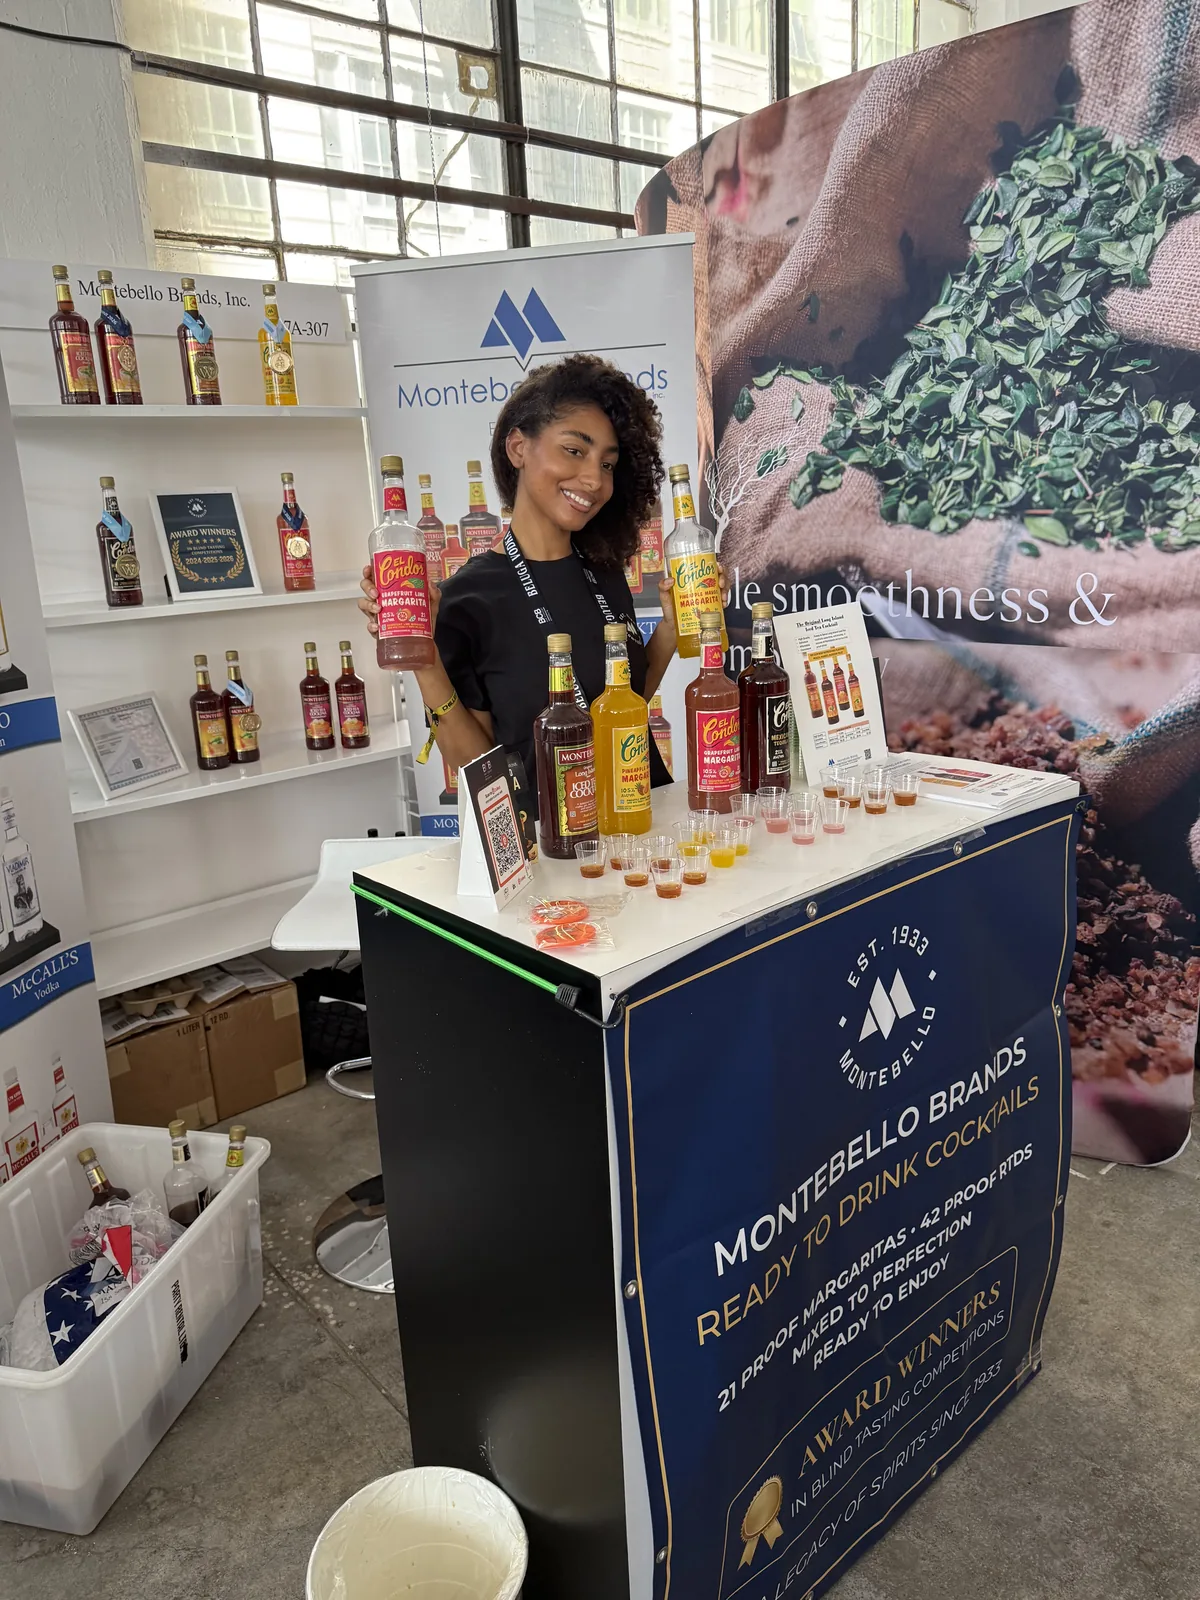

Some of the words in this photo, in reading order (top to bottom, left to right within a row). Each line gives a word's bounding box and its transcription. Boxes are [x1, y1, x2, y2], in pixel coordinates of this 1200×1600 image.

[167, 287, 222, 307] Brnds,
[225, 291, 250, 307] Inc.
[170, 529, 198, 540] AWARD
[200, 528, 237, 536] WINNERS
[504, 531, 521, 561] VODKA
[393, 556, 405, 567] EL
[690, 561, 698, 570] EL
[515, 561, 538, 597] BELUGA
[381, 590, 413, 598] GRAPEFRUIT
[381, 598, 427, 608] MARGARITA
[679, 592, 703, 600] PINEAPPLE
[680, 595, 719, 608] MARGARITA
[772, 568, 1049, 622] smoothness
[1068, 572, 1119, 626] &
[534, 608, 546, 624] BCB
[594, 594, 617, 624] BELUG
[718, 718, 729, 728] EL
[636, 735, 645, 744] EL
[621, 766, 646, 774] PINEAPPLE
[572, 780, 590, 791] ICED
[847, 938, 885, 988] EST.
[891, 925, 929, 956] 1933
[34, 980, 60, 1001] Vodka
[176, 1028, 181, 1037] 1
[182, 1021, 201, 1036] LITER
[209, 1016, 218, 1026] 12
[839, 1006, 936, 1090] MONTEBELLO
[713, 1105, 920, 1277] MONTEBELLO
[928, 1036, 1027, 1124] BRANDS
[696, 1244, 798, 1346] READY
[802, 1214, 831, 1259] TO
[838, 1151, 919, 1227] DRINK
[925, 1075, 1040, 1168] COCKTAILS
[717, 1381, 737, 1413] 21
[741, 1316, 799, 1389] PROOF
[802, 1226, 907, 1325] MARGARITAS
[920, 1205, 940, 1229] 42
[943, 1171, 997, 1216] PROOF
[999, 1142, 1034, 1181] RTDS
[792, 1306, 844, 1365] MIXED
[847, 1283, 869, 1311] TO
[872, 1211, 972, 1291] PERFECTION
[171, 1279, 181, 1308] PARTY
[174, 1303, 185, 1336] RENTAL
[813, 1309, 870, 1371] READY
[872, 1292, 893, 1320] TO
[898, 1252, 950, 1302] ENJOY
[797, 1375, 892, 1479] AWARD
[897, 1280, 1002, 1379] WINNERS
[790, 1497, 807, 1518] IN
[810, 1445, 853, 1499] BLIND
[854, 1390, 910, 1449] TASTING
[913, 1309, 1005, 1396] COMPETITIONS
[775, 1513, 842, 1600] LEGACY
[844, 1488, 869, 1522] OF
[869, 1434, 927, 1498] SPIRITS
[929, 1384, 973, 1440] SINCE
[972, 1358, 1003, 1394] 1933
